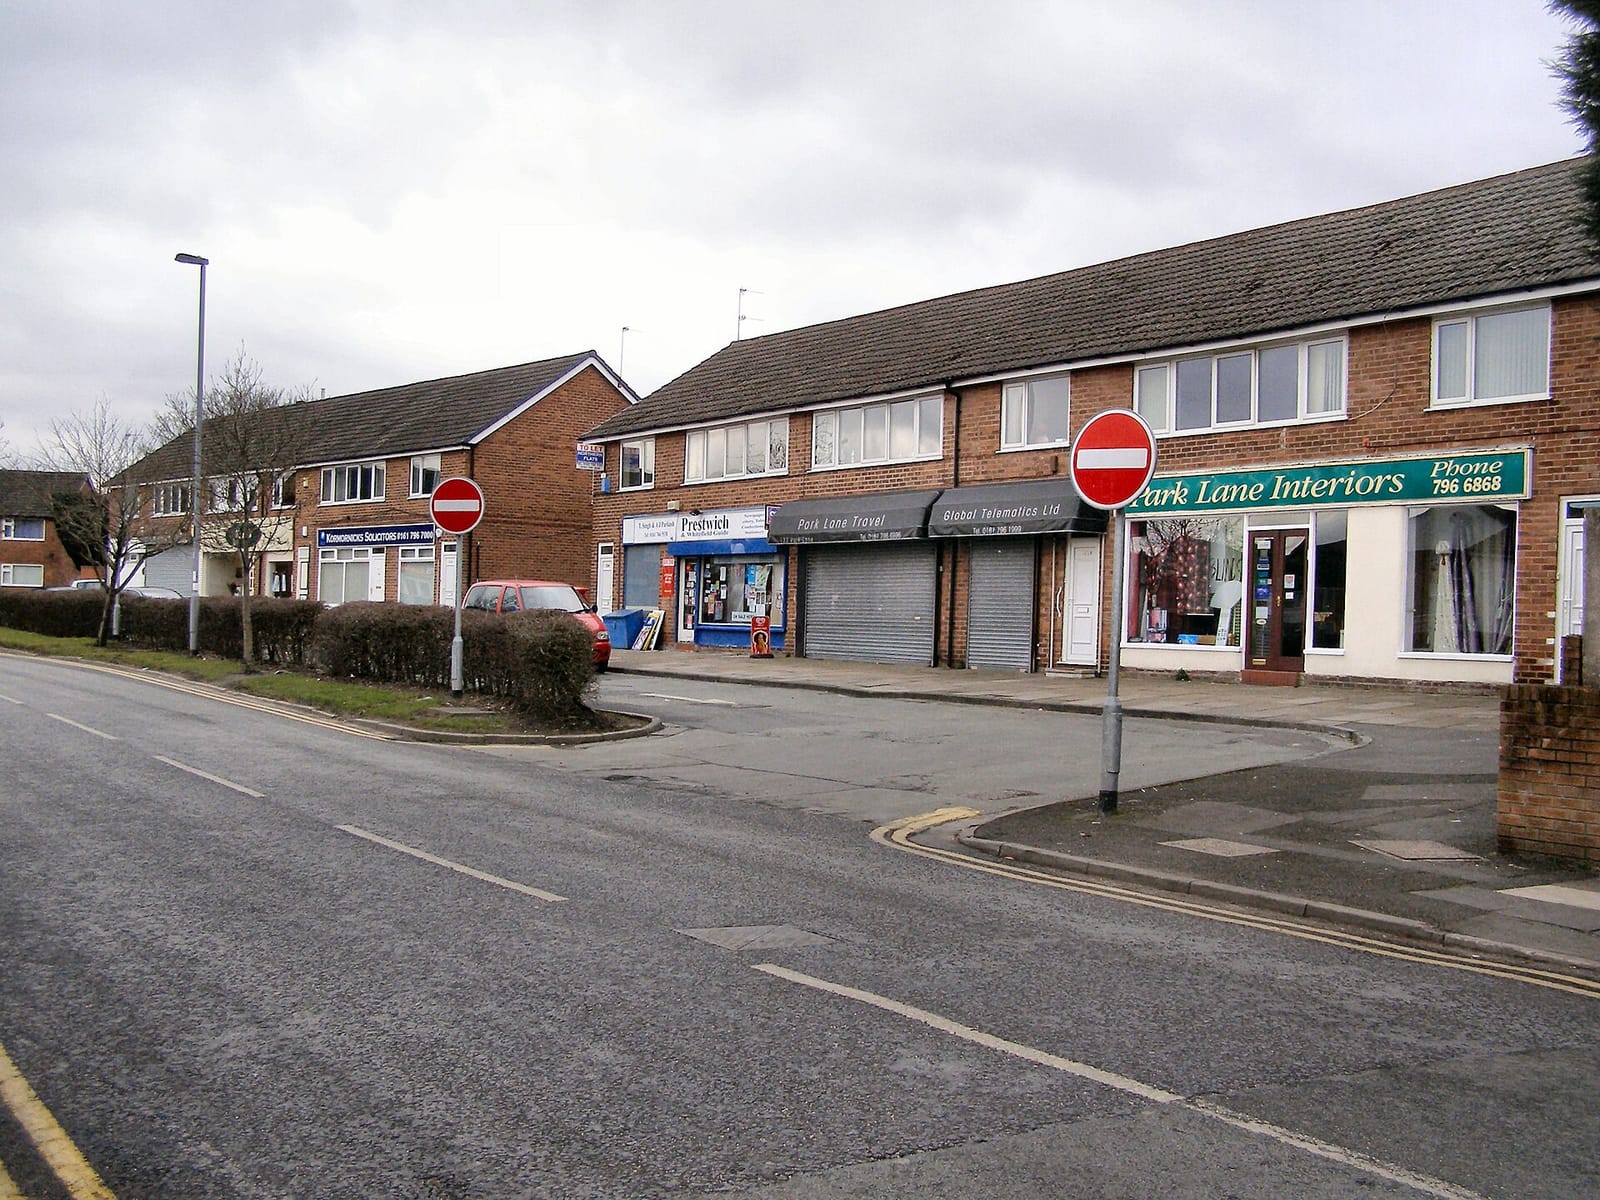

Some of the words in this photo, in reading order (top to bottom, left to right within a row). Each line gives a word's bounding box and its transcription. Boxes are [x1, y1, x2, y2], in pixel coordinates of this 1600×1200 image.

[579, 444, 589, 452] TO
[1430, 460, 1504, 478] Phone
[1195, 480, 1264, 504] Lane
[1269, 470, 1405, 500] Interiors
[1432, 478, 1459, 495] 796
[1463, 476, 1502, 493] 6868
[943, 510, 977, 521] Global
[981, 506, 1038, 519] Telematics
[1043, 503, 1061, 516] Ltd
[682, 514, 729, 531] Prestwich
[797, 518, 819, 531] Park
[823, 517, 847, 530] Lane
[852, 514, 886, 528] Travel
